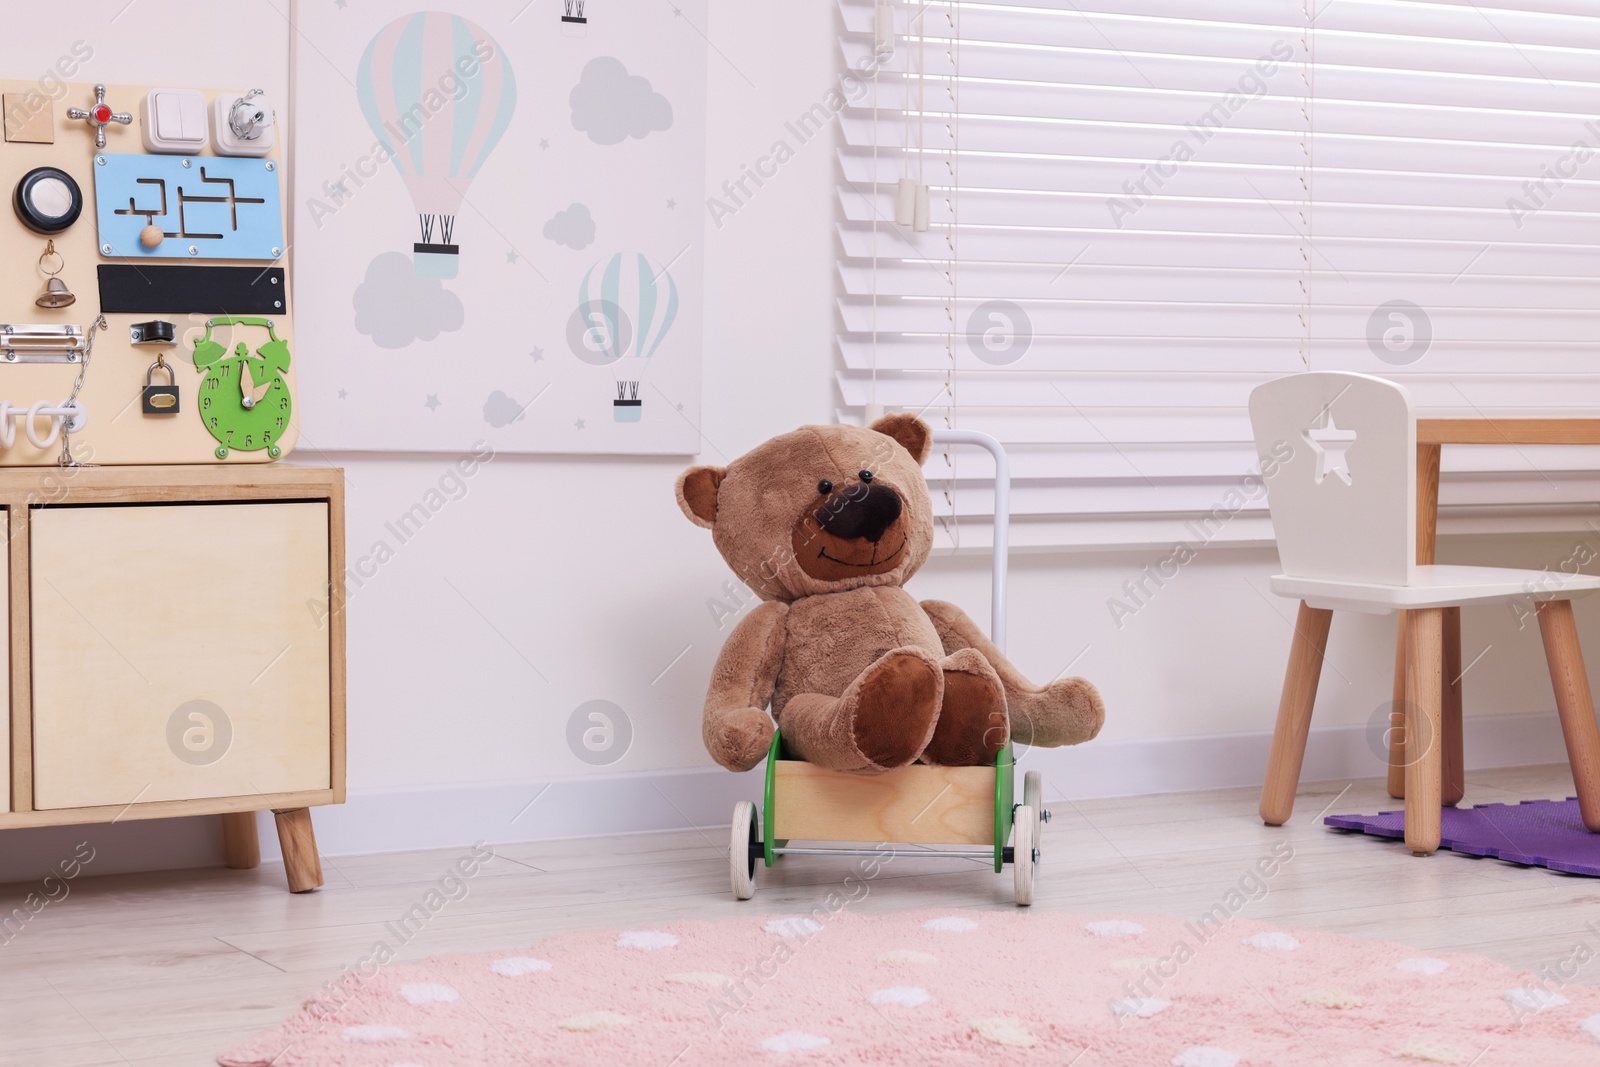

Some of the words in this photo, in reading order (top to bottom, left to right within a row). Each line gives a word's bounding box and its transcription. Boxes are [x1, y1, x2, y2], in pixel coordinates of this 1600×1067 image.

[220, 365, 230, 377] 11
[260, 365, 265, 377] 1
[206, 378, 220, 390] 10
[274, 378, 281, 390] 2
[203, 397, 211, 410] 9
[280, 397, 288, 410] 3
[210, 417, 218, 429] 8
[276, 417, 283, 429] 4
[226, 430, 234, 443] 7
[245, 434, 252, 447] 6
[263, 430, 271, 443] 5
